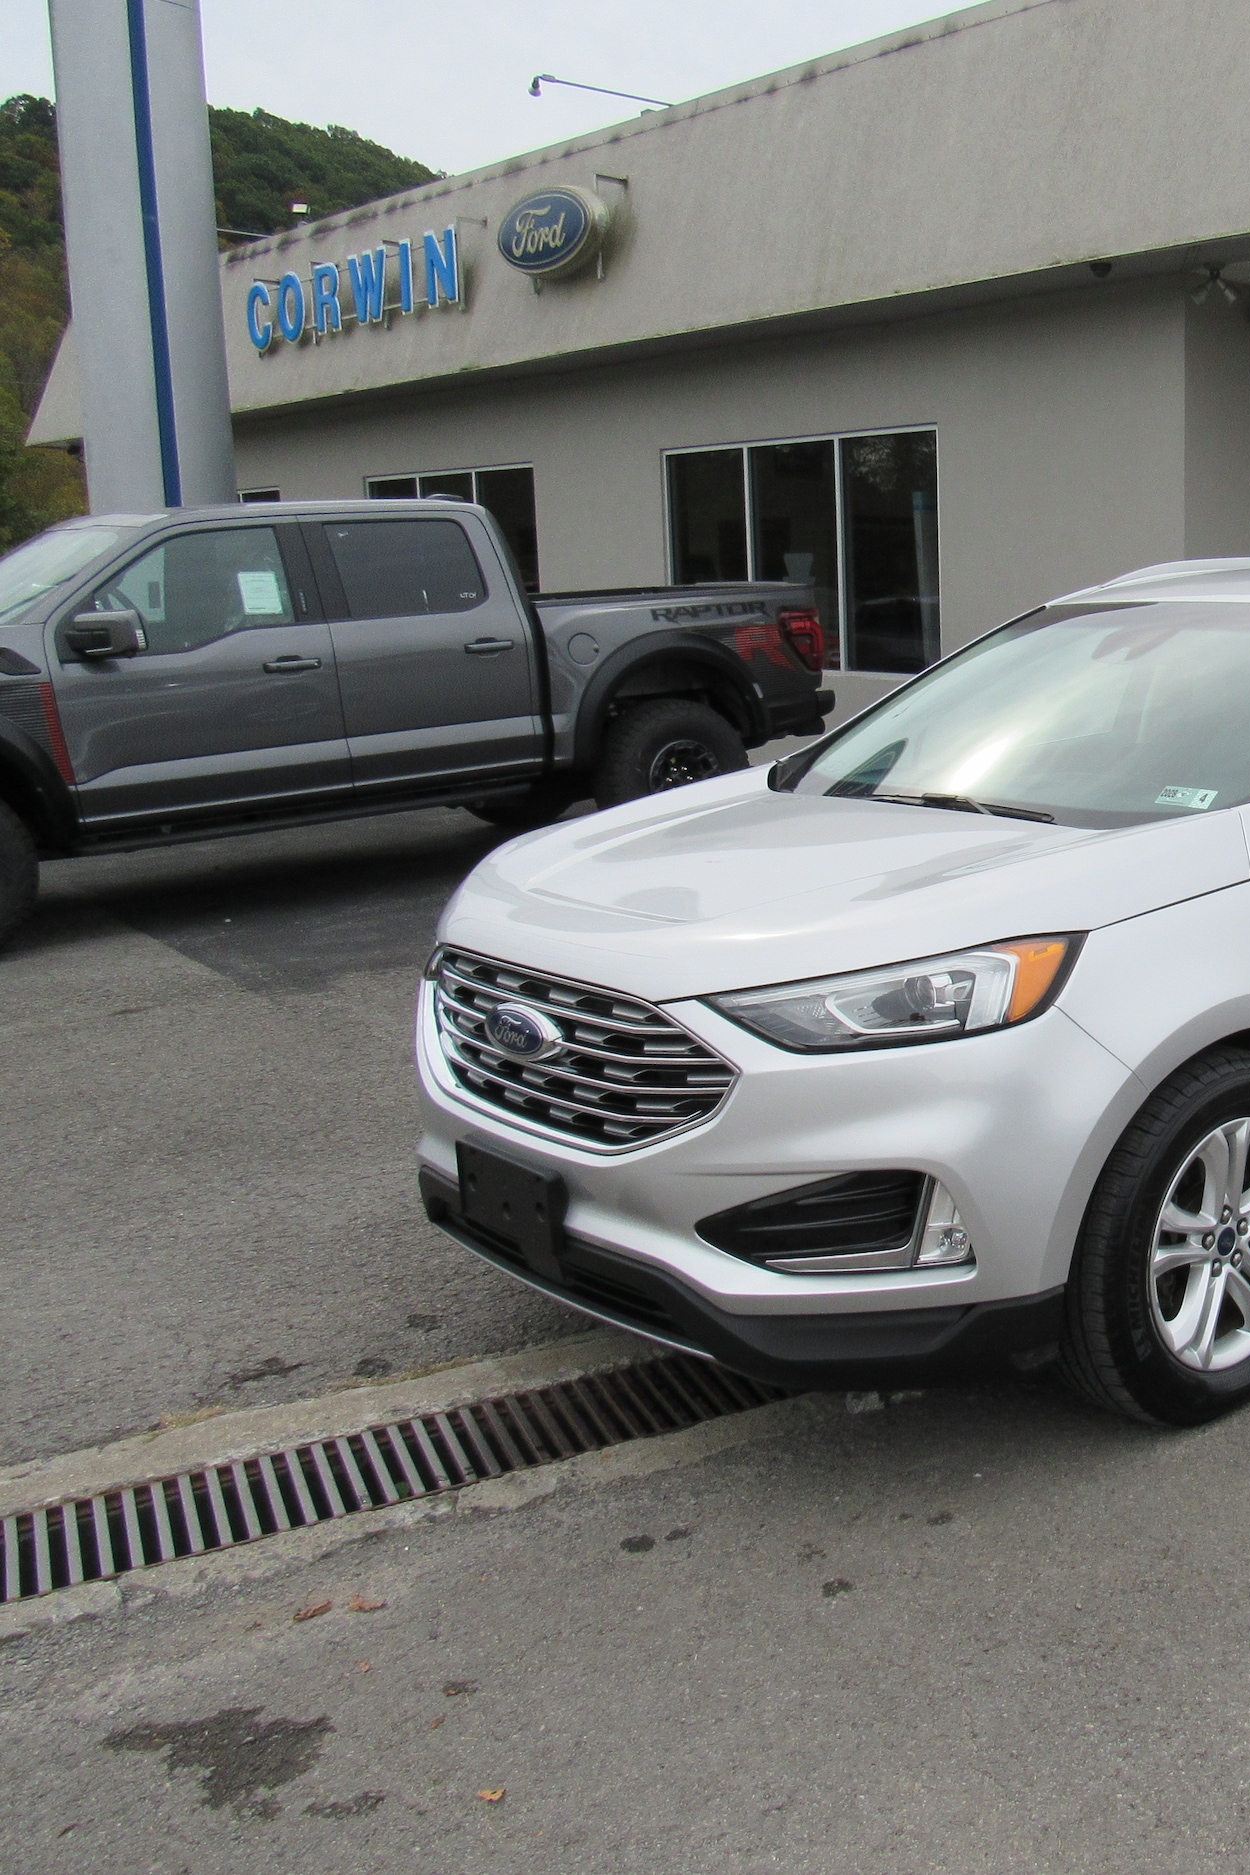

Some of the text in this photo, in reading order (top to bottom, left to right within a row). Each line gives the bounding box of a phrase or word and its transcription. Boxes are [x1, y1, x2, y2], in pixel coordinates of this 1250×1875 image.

[512, 205, 567, 257] Ford
[247, 223, 460, 353] CORWIN
[651, 600, 773, 626] RAPTOR
[495, 1015, 528, 1047] Ford
